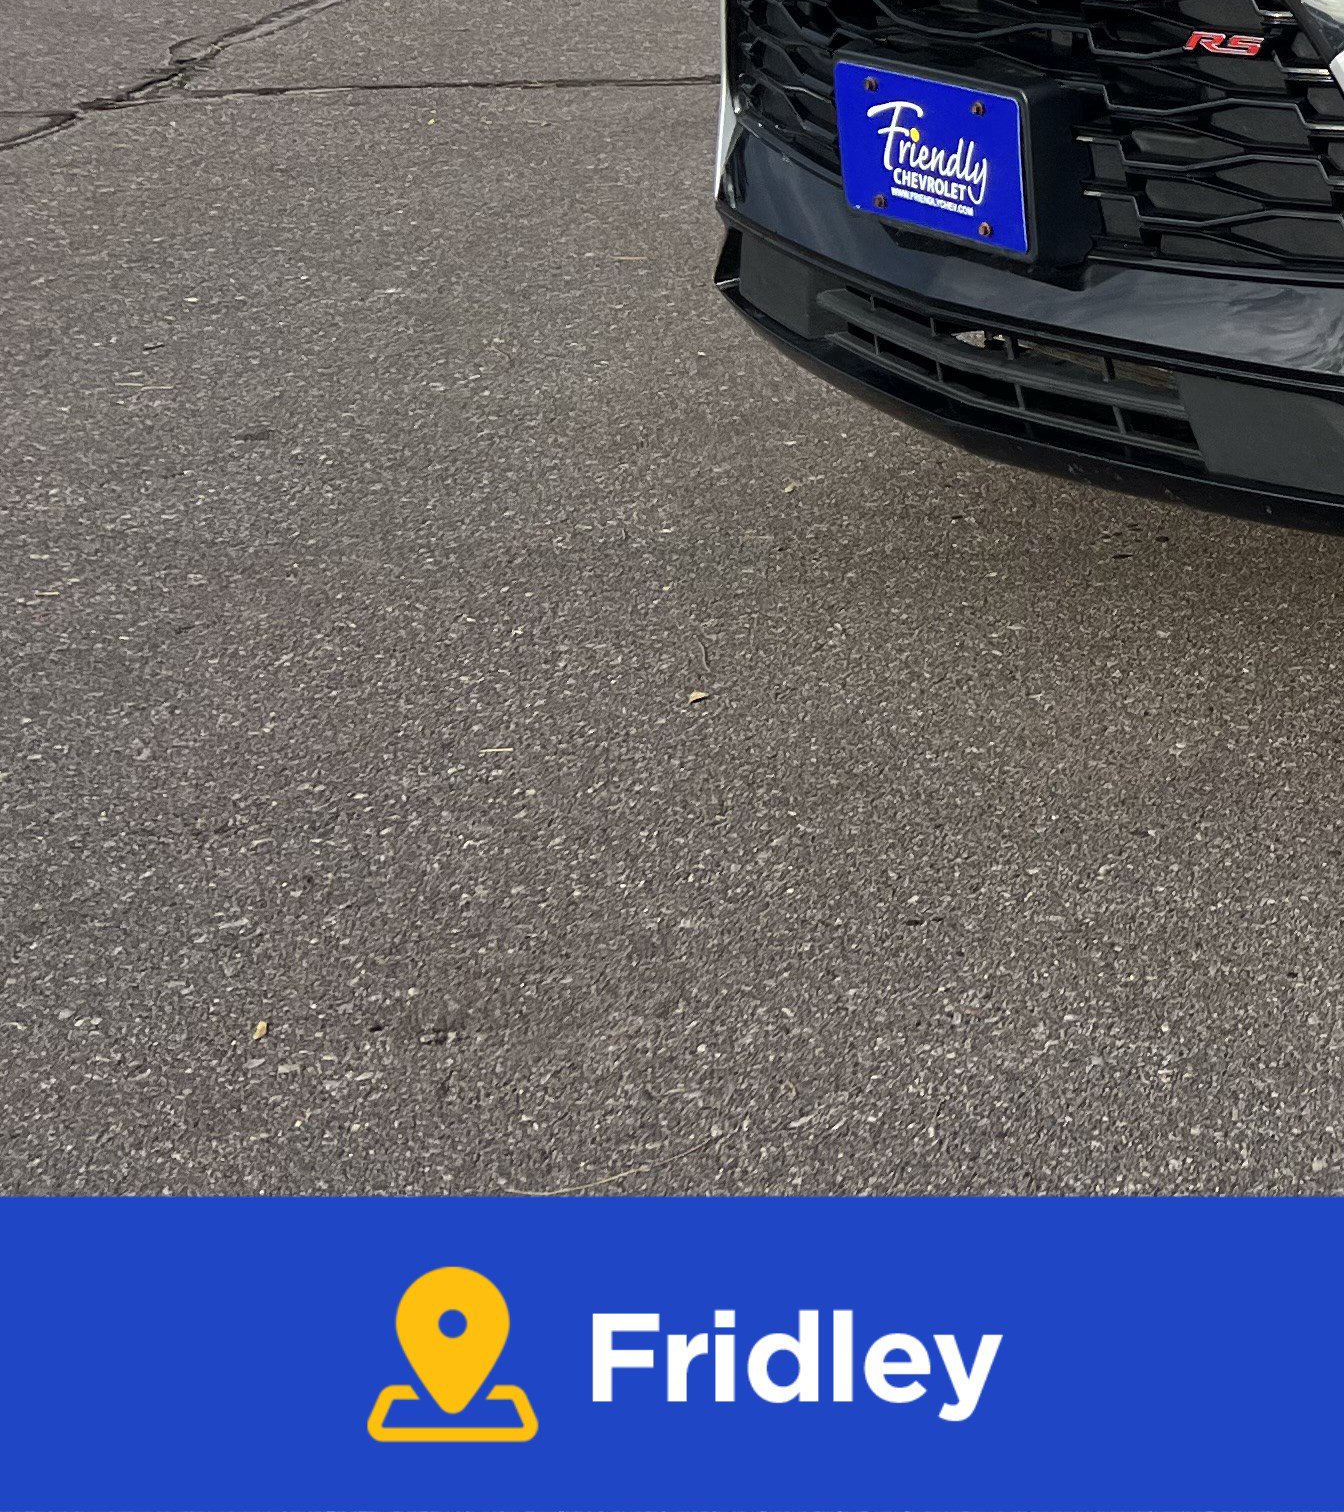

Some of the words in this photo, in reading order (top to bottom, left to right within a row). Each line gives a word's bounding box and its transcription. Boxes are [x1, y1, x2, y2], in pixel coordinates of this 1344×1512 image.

[1184, 31, 1264, 56] RS
[867, 101, 987, 205] Friendly
[893, 168, 967, 201] CHEVROLET
